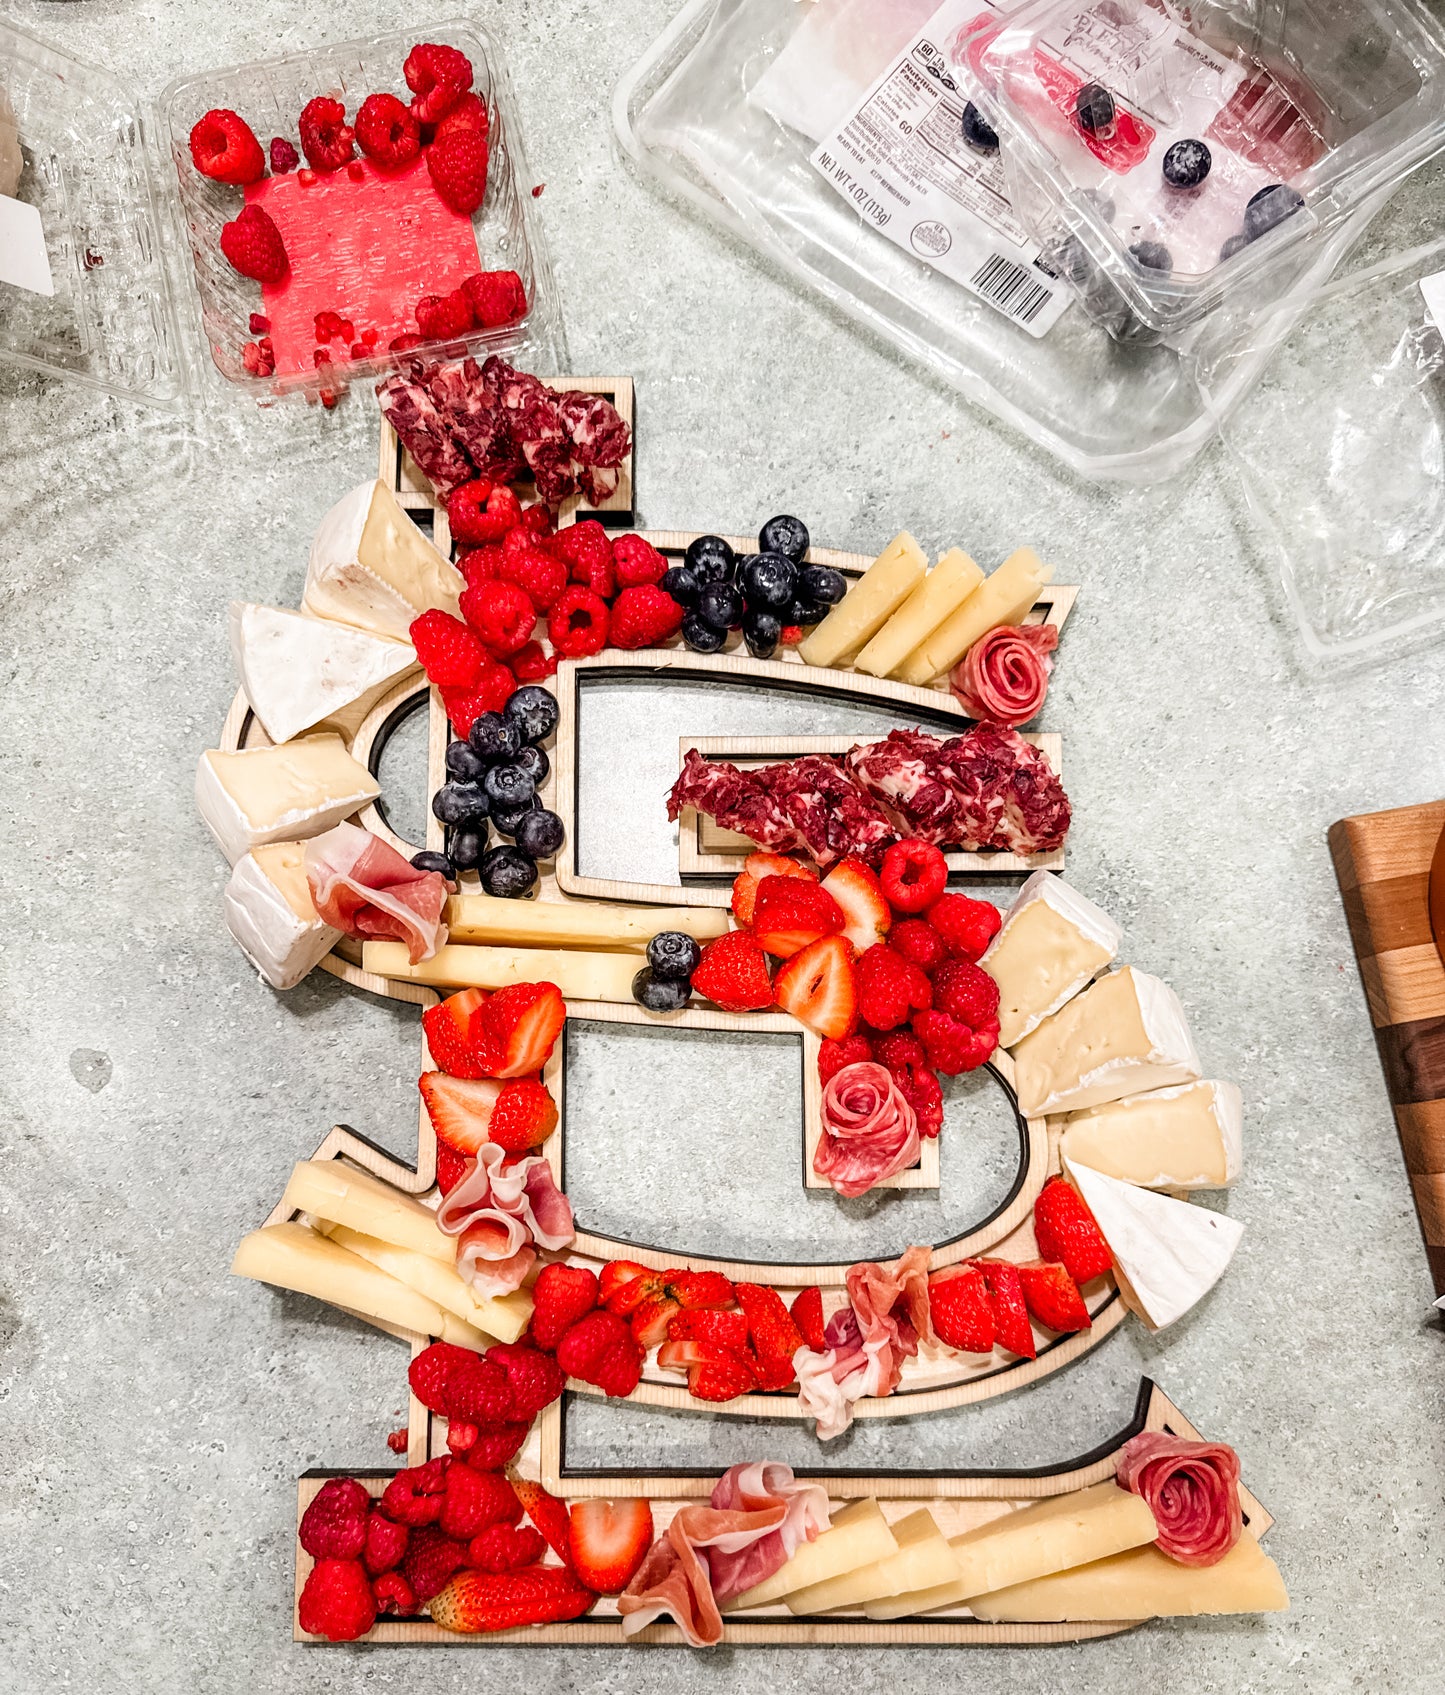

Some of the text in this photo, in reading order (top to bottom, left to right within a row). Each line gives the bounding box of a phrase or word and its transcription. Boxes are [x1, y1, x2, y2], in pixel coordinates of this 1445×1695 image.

[921, 43, 934, 56] 60
[900, 69, 921, 92] Facts
[904, 63, 939, 98] Nutrition
[876, 95, 900, 120] Calories
[948, 114, 957, 124] Fat
[899, 120, 913, 135] 60
[818, 152, 892, 226] NET WT 4 OZ (113g)
